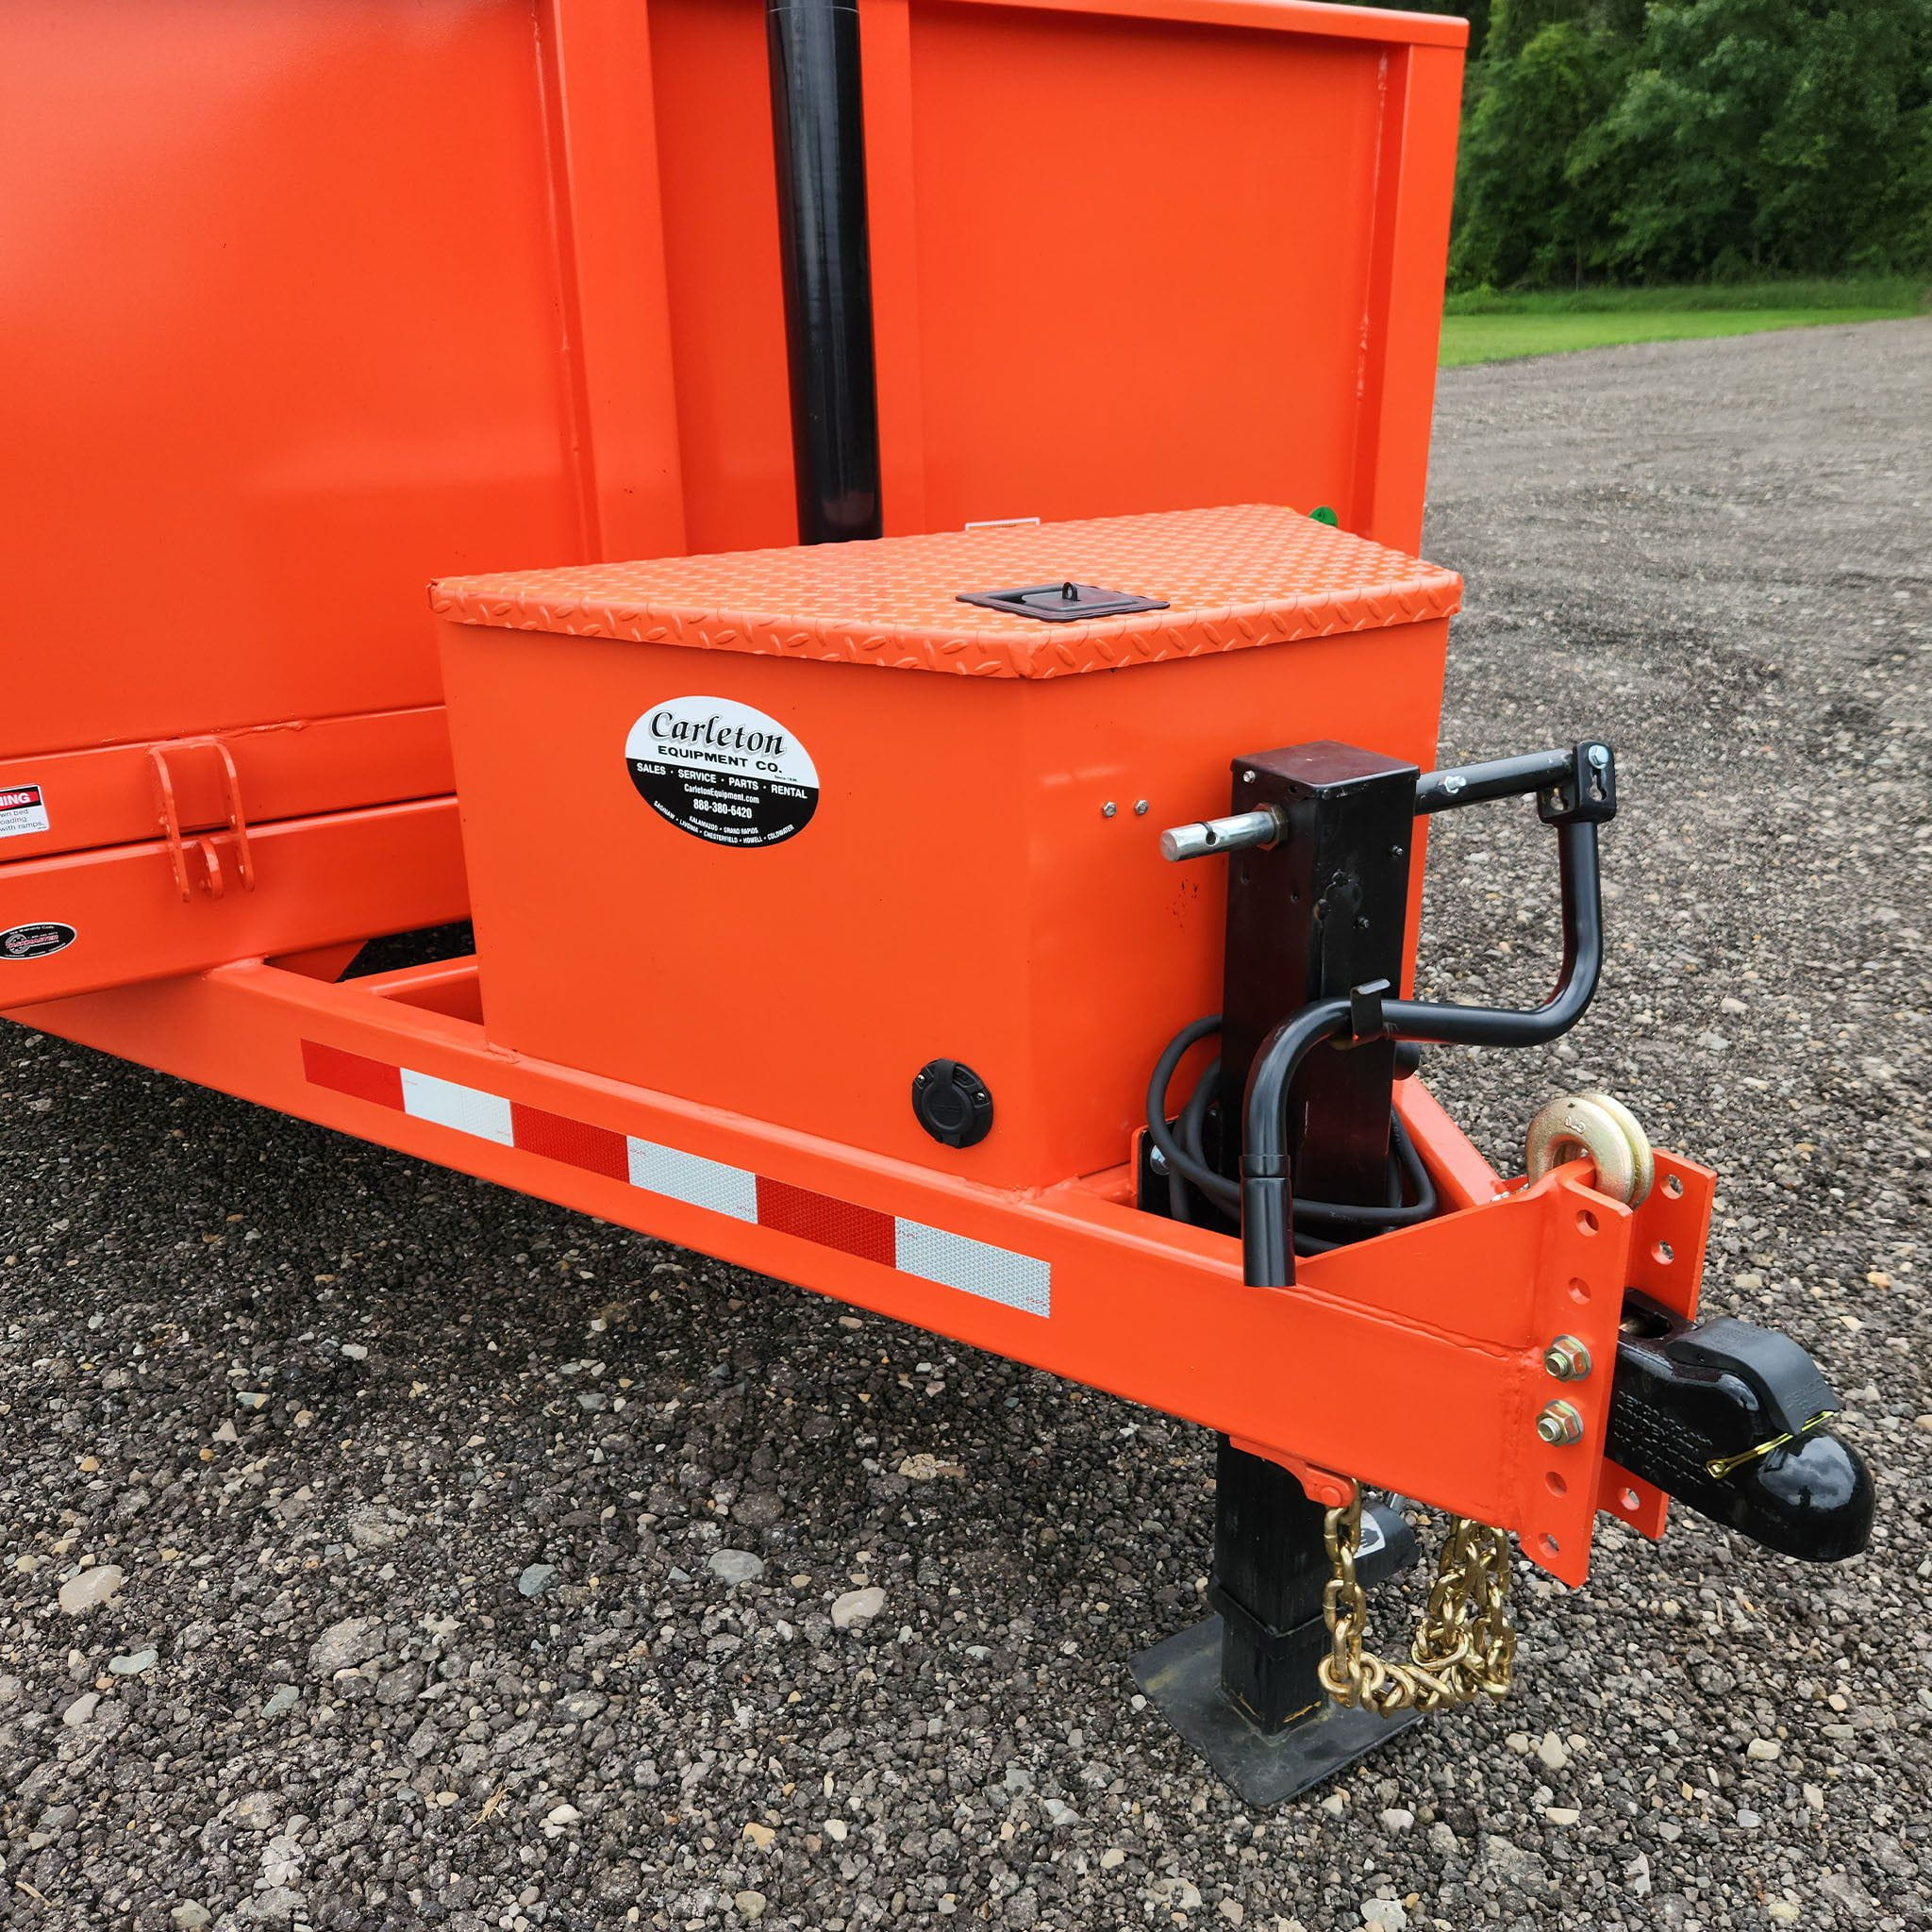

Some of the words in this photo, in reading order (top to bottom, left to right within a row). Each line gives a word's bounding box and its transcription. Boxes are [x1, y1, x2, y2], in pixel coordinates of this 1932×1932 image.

[650, 710, 786, 757] Carleton
[658, 745, 748, 768] EQUIPMENT
[756, 760, 783, 774] CO.
[636, 761, 667, 775] SALES
[677, 768, 717, 784] SERVICE
[728, 776, 759, 791] PARTS
[771, 784, 808, 799] RENTAL
[684, 783, 760, 805] CarletonEquipment.com
[692, 798, 753, 819] 888-380-6420
[689, 815, 719, 831] KALAMAZOO
[703, 830, 739, 843] CHESTERFIELD
[767, 824, 795, 841] COLDWATER
